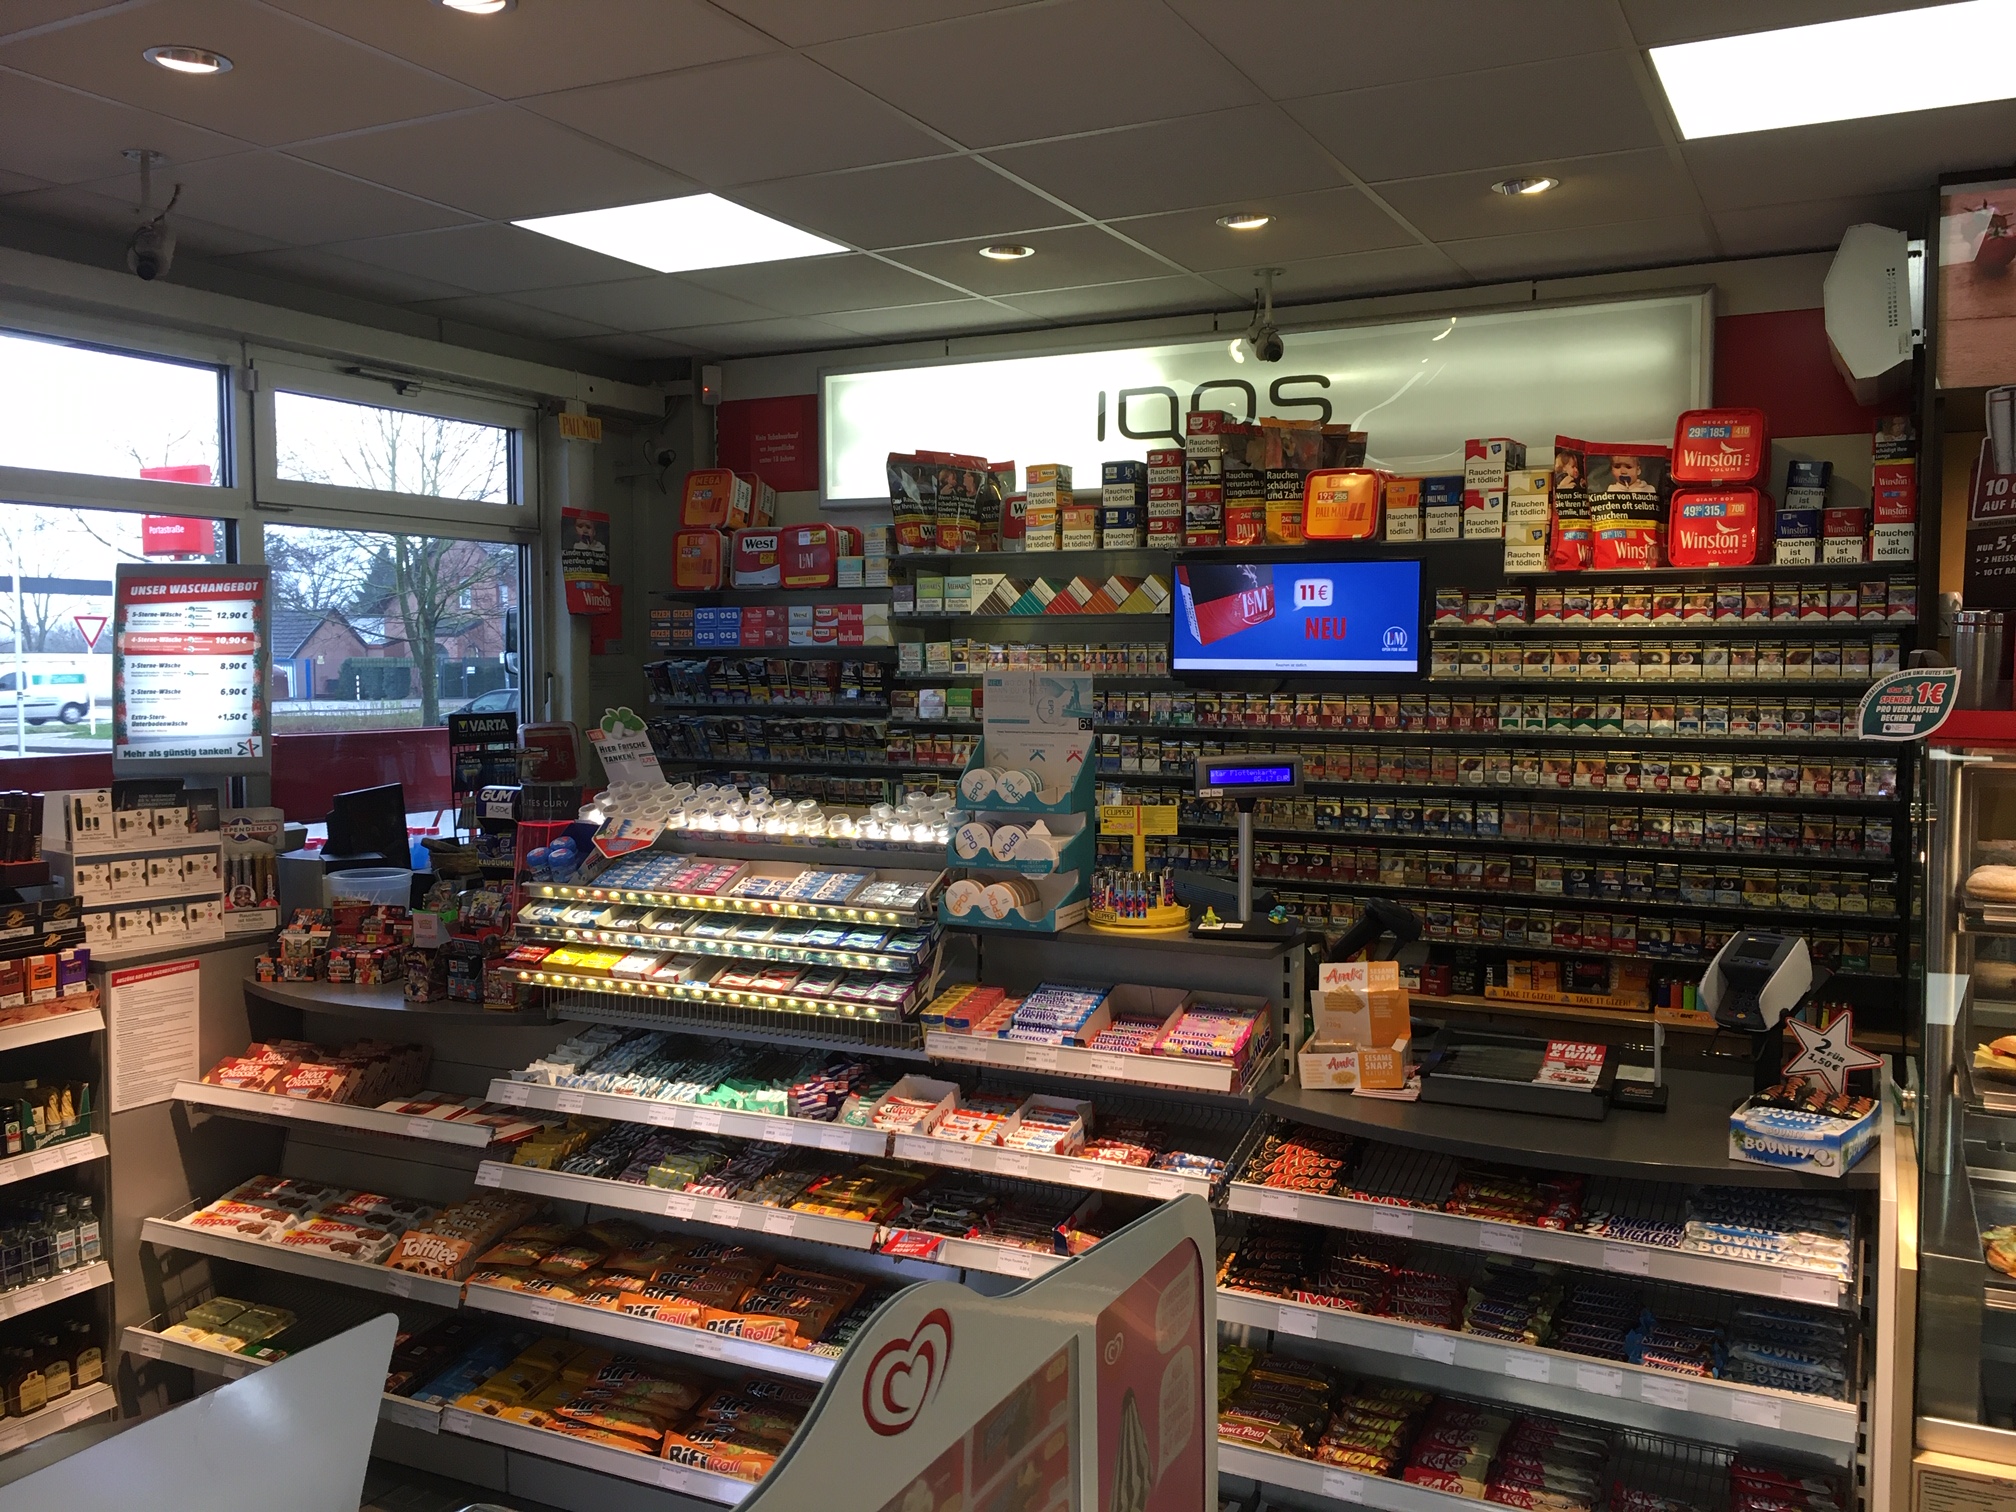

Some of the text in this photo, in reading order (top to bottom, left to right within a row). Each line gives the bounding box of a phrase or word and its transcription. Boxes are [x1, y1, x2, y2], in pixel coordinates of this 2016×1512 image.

[1097, 375, 1333, 447] IQOS
[1187, 445, 1220, 453] ist tödlich
[1684, 449, 1742, 467] Winston
[1266, 470, 1299, 480] Rauchen
[1468, 468, 1502, 476] Rauchen
[1466, 475, 1503, 484] ist tödlich
[1266, 480, 1300, 491] schädigt
[1985, 478, 2009, 496] 10
[1267, 490, 1281, 499] und
[1589, 492, 1615, 502] Kinder
[1510, 500, 1545, 508] Rauchen
[1590, 501, 1655, 512] werden oft selbst
[1731, 504, 1745, 513] 700
[1982, 500, 2006, 512] AUF
[1315, 505, 1348, 518] PALL MALL
[1387, 512, 1418, 520] Rauchen
[1426, 511, 1458, 519] Rauchen
[1509, 507, 1546, 516] ist tödlich
[1591, 511, 1629, 522] Rauchern
[1878, 506, 1908, 516] Winston
[149, 524, 185, 534] Portastraße
[1389, 527, 1414, 535] tödlich
[1429, 526, 1454, 534] tödlich
[1874, 529, 1914, 537] Rauchen
[745, 538, 774, 549] West
[1680, 530, 1739, 549] Winston
[1887, 538, 1900, 546] ist
[1877, 547, 1910, 555] tödlich
[1976, 543, 1994, 552] NUR
[1993, 567, 2003, 575] CT
[130, 581, 259, 596] UNSER WASCHANGEBOT
[1300, 584, 1328, 601] 11 €
[1242, 587, 1269, 618] L&M
[650, 610, 671, 619] GIZEH
[672, 609, 693, 618] GIZEH
[696, 612, 715, 620] OCB
[838, 608, 863, 622] Marlboro
[1305, 617, 1347, 640] NEU
[215, 637, 241, 645] 10,90
[220, 662, 240, 670] 8,90
[220, 688, 240, 696] 6,90
[1879, 695, 1914, 704] SPENDET
[1876, 705, 1940, 713] PRO VERKAUFTEN
[217, 713, 240, 721] +1,50
[1910, 714, 1922, 722] AN
[468, 719, 509, 732] VARTA
[123, 747, 233, 758] Mehr als günstig tanken!
[599, 741, 647, 754] HIER FRISCHE
[604, 751, 635, 763] TANKEN!
[480, 789, 514, 802] GUM
[543, 799, 569, 807] CURV
[999, 832, 1020, 857] EPOK
[478, 858, 514, 867] KAUGUMMI
[952, 888, 973, 914] EPOK
[1502, 989, 1556, 1000] TAKE IT GIZEH!
[1117, 1020, 1160, 1029] mentos
[1169, 1037, 1214, 1048] mentos
[1551, 1042, 1597, 1053] WASH
[1814, 1038, 1846, 1063] 2 FÜR
[1364, 1054, 1393, 1062] SESAME
[1564, 1051, 1603, 1062] WIN!
[1364, 1061, 1393, 1070] SNAPS
[1807, 1053, 1841, 1072] 1,50 €
[298, 1070, 328, 1079] CHOCO
[285, 1076, 326, 1088] CROSSIES
[885, 1105, 916, 1116] duplo
[1098, 1148, 1129, 1160] YES!
[1744, 1137, 1811, 1160] BOUNTY
[191, 1216, 240, 1228] nippon
[1605, 1225, 1680, 1247] SNICKERS
[401, 1237, 459, 1265] Toffifee
[1697, 1241, 1785, 1264] BOUNTY
[1217, 1423, 1265, 1439] PRINCE POLO
[707, 1455, 741, 1473] Roll
[1334, 1451, 1382, 1468] LION
[1425, 1453, 1466, 1468] KitKat
